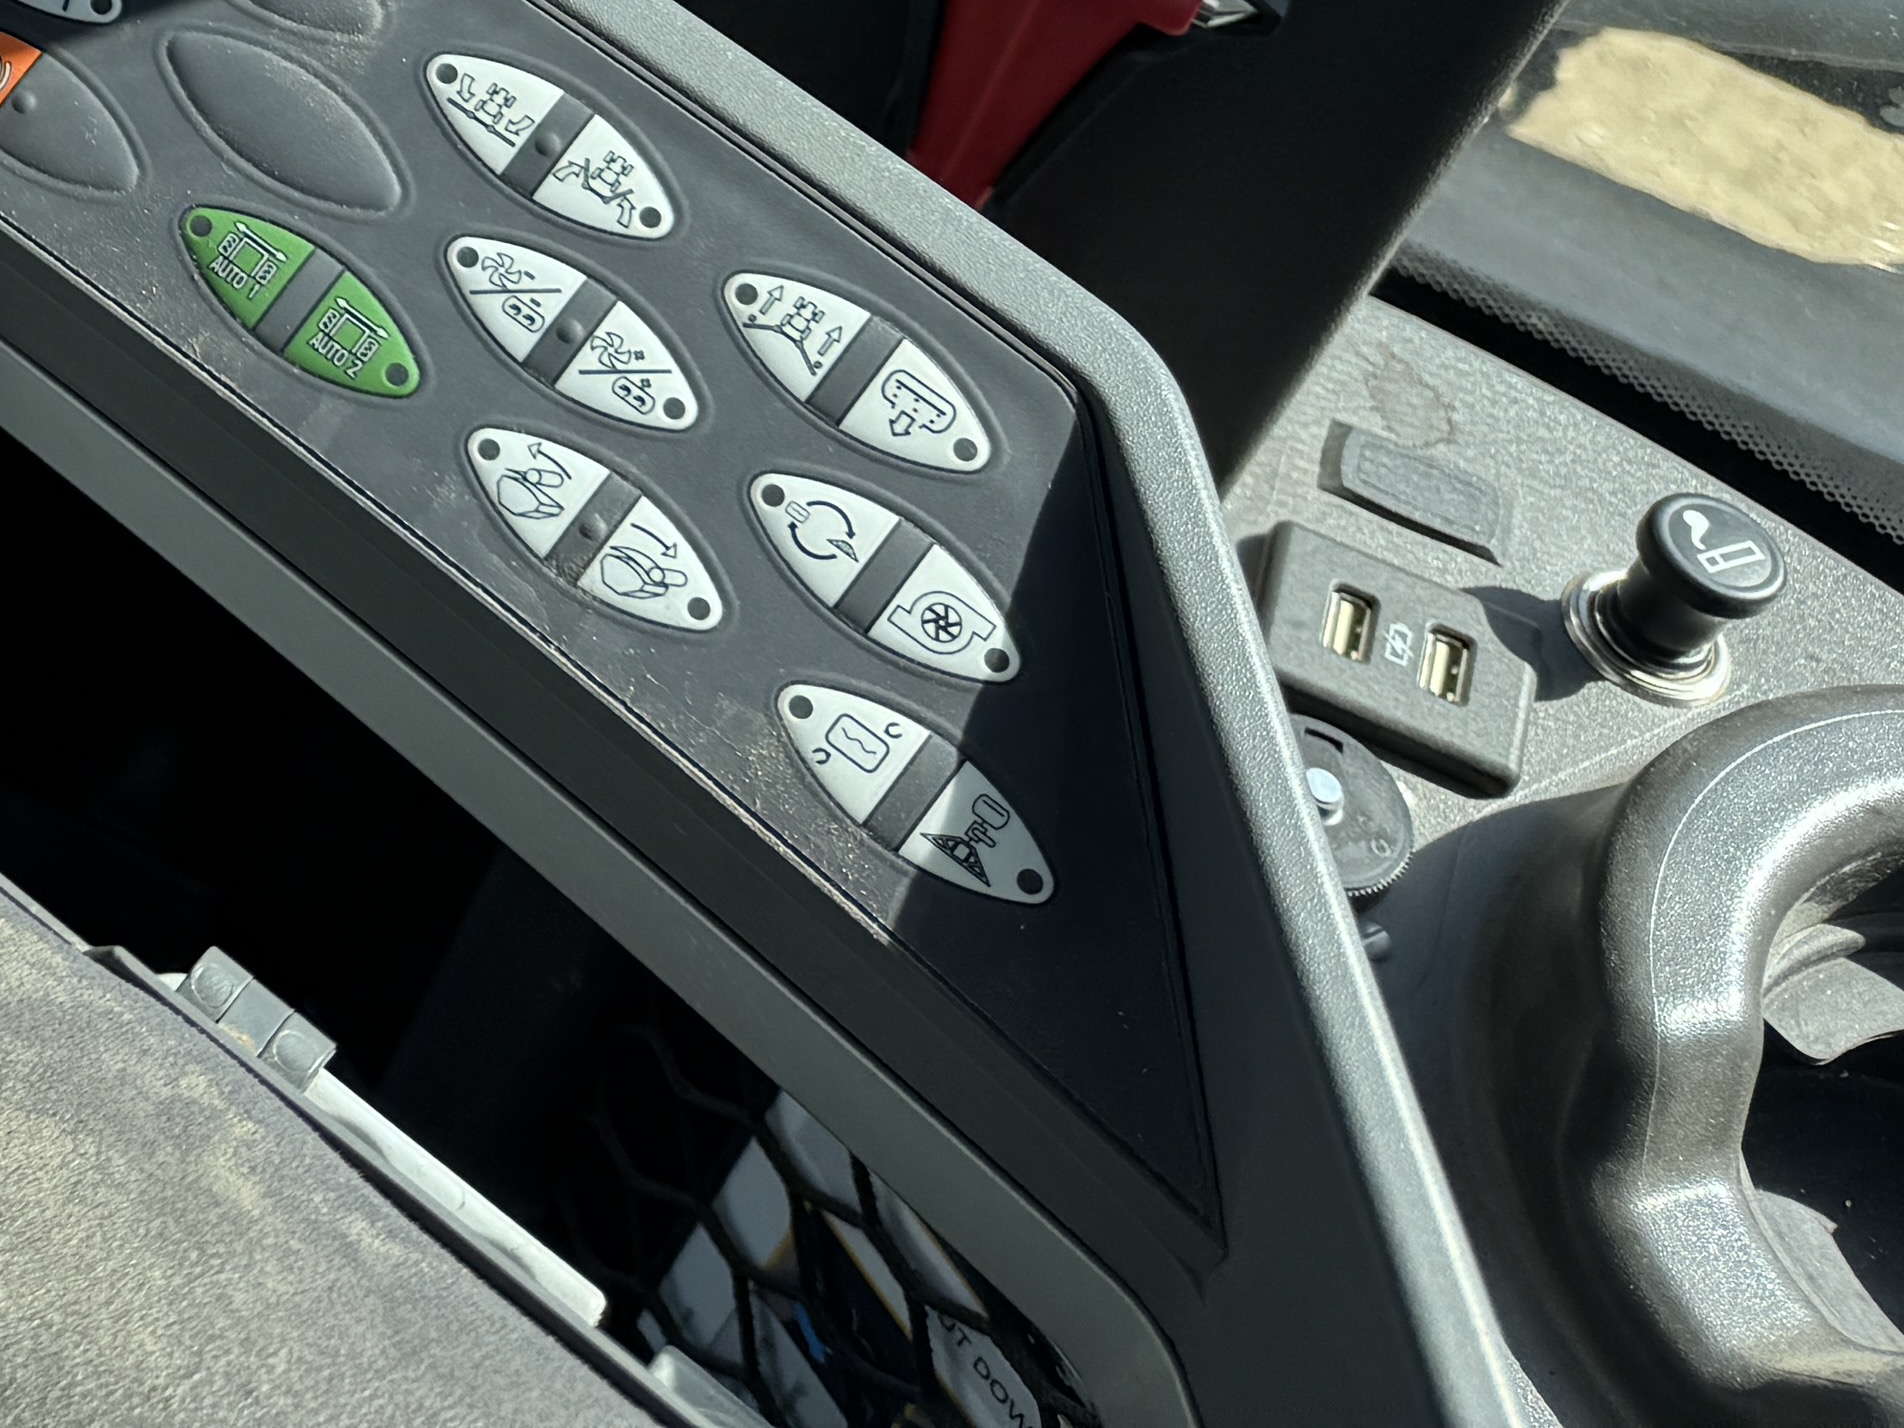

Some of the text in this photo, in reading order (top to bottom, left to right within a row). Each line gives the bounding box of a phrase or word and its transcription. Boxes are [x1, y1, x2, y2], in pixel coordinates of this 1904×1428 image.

[209, 255, 248, 291] AUTO
[308, 332, 363, 380] AUTO 2
